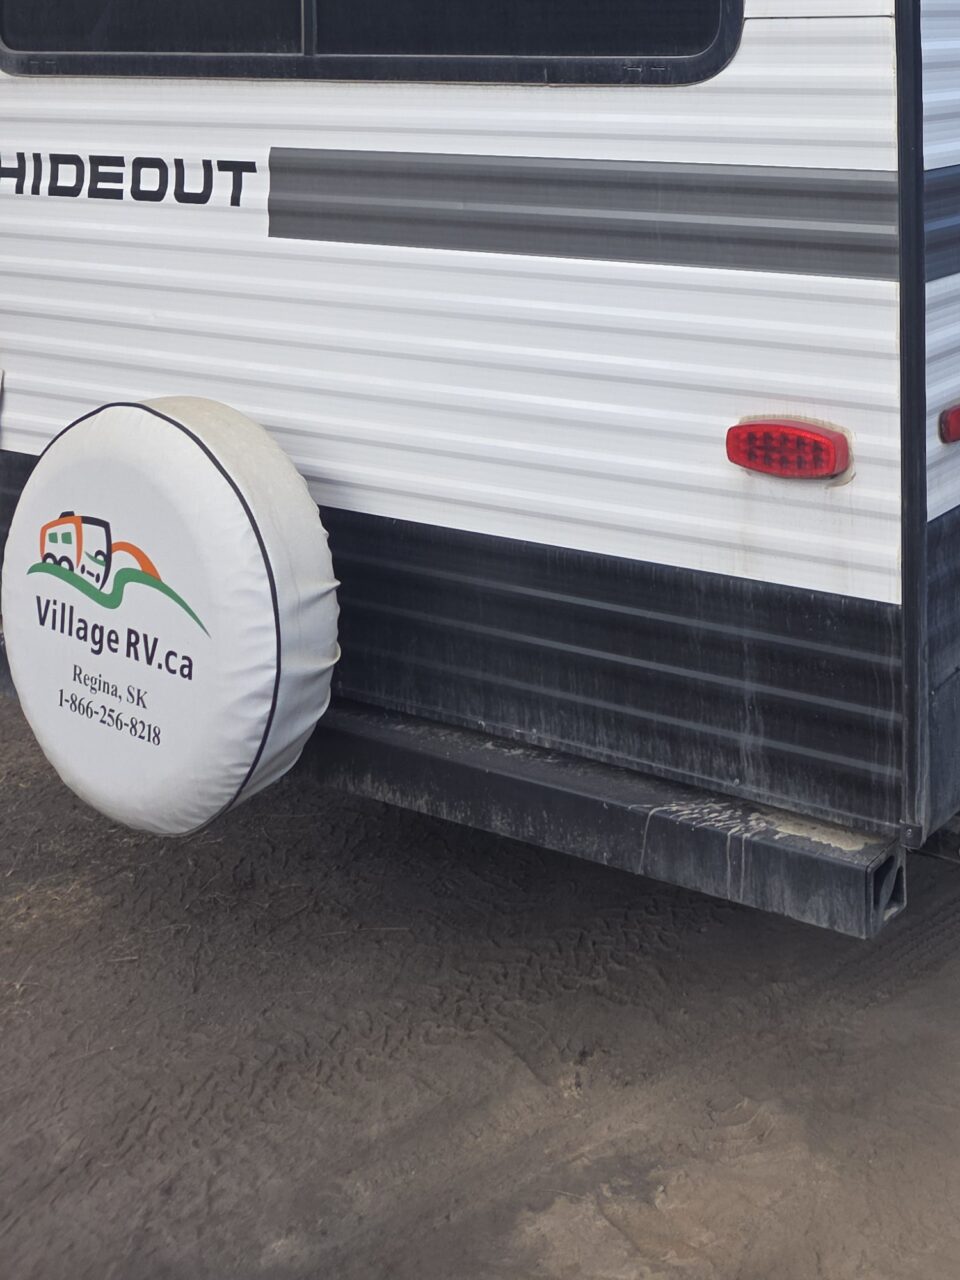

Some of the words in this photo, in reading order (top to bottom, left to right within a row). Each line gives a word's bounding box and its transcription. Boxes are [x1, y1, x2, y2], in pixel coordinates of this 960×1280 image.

[0, 152, 257, 207] HIDEOUT
[72, 664, 122, 703] Regina,
[126, 684, 148, 710] SK
[58, 688, 161, 746] 1-866-256-8218
